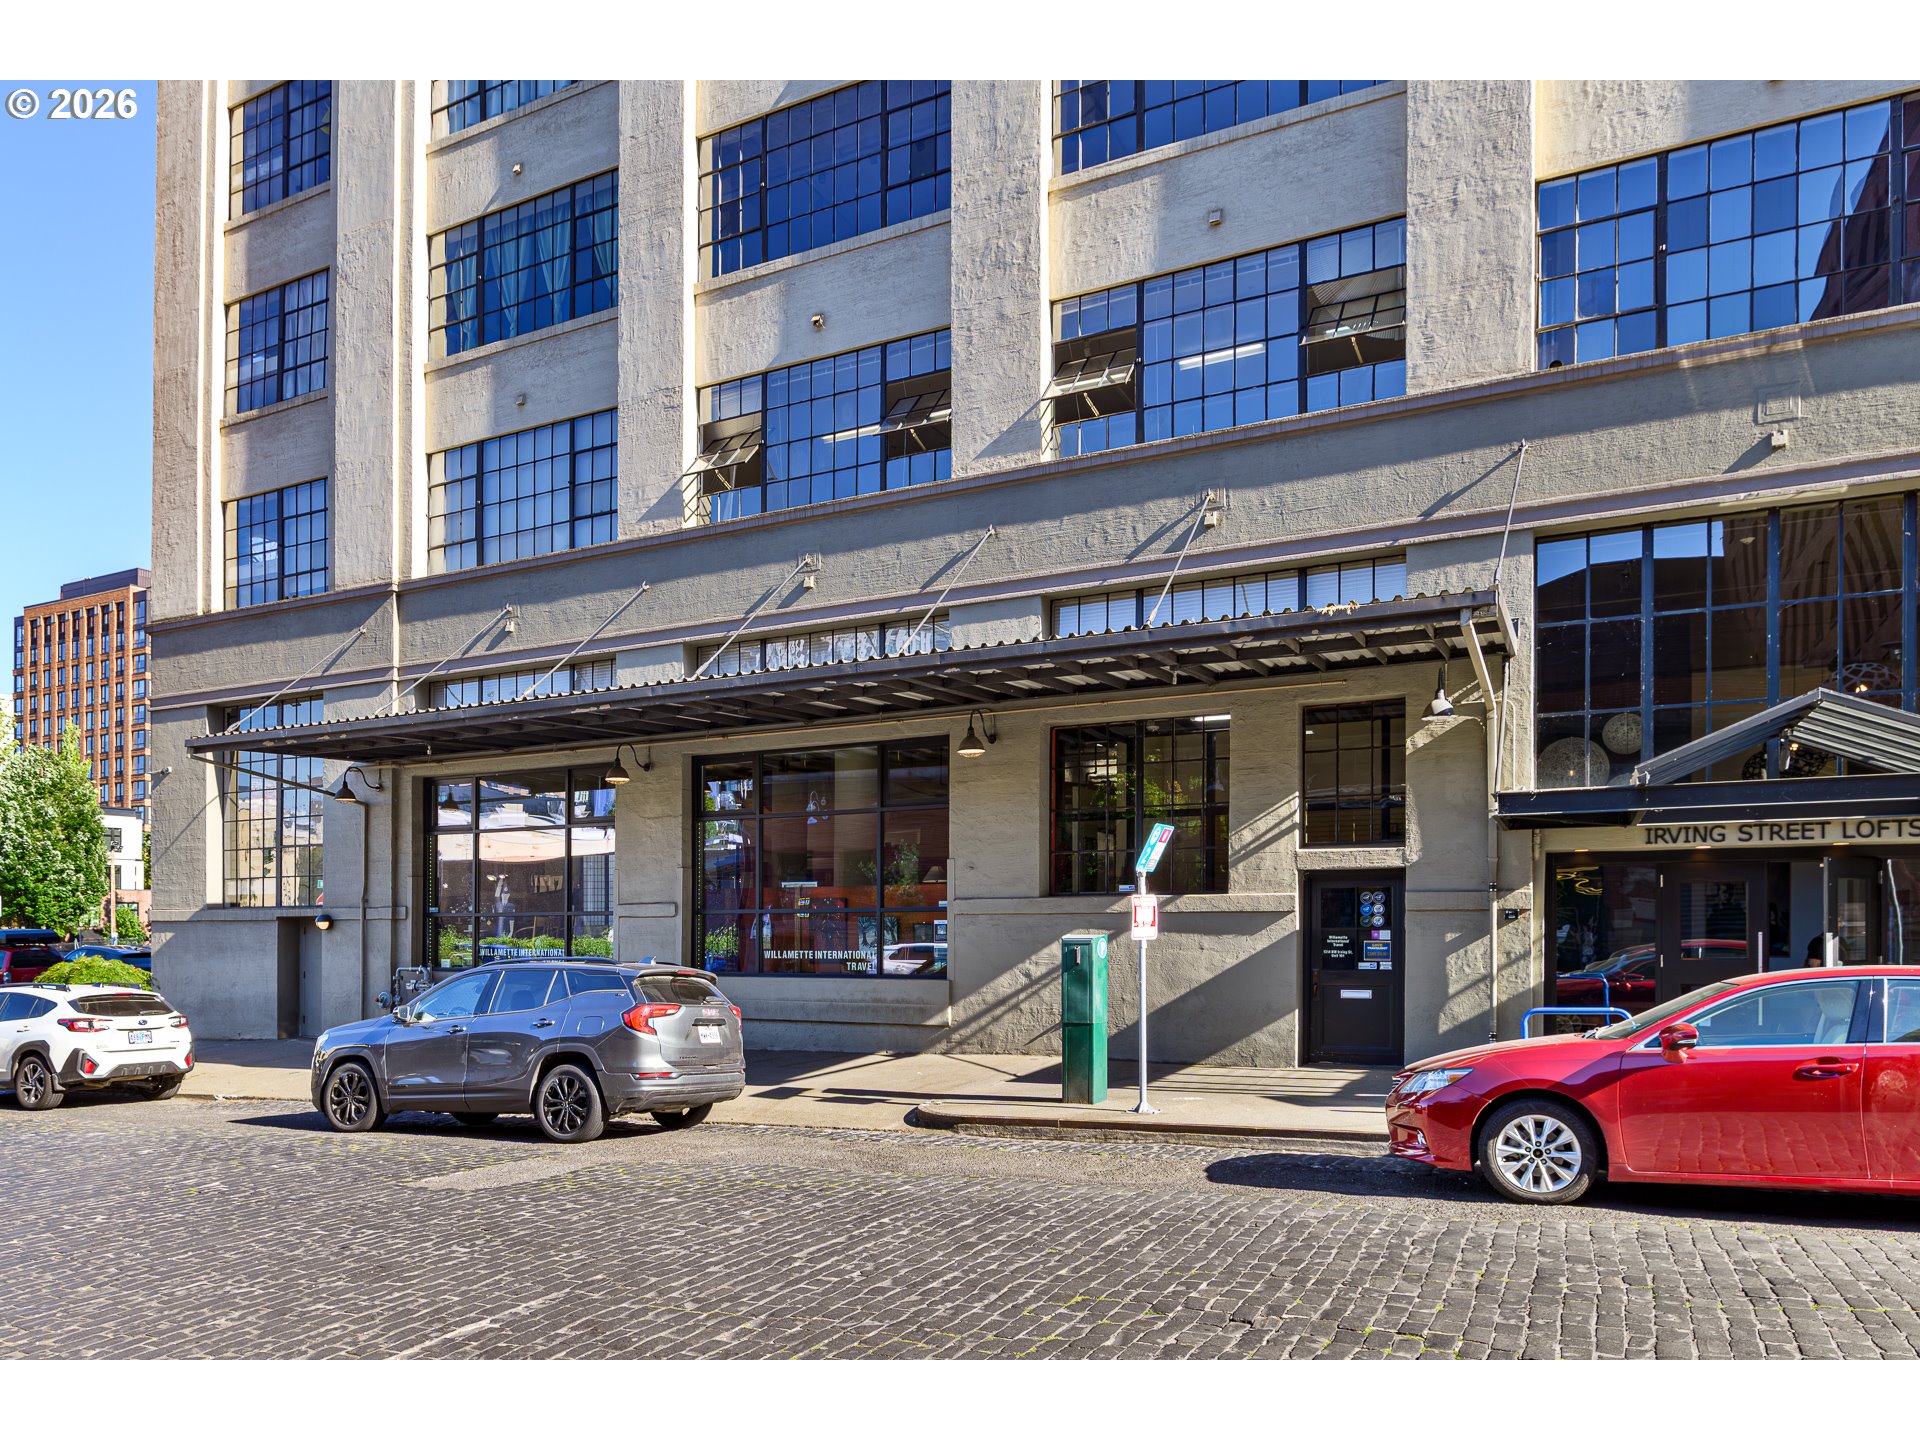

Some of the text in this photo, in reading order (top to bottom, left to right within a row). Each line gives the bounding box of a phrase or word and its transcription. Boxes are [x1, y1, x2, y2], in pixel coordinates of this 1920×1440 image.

[1645, 818, 1920, 845] IRVING STREET LOFTS
[480, 948, 518, 957] WILLAMETTE
[763, 950, 877, 960] WILLAMETTE INTERNATIONAL
[846, 961, 876, 971] TRAVEL
